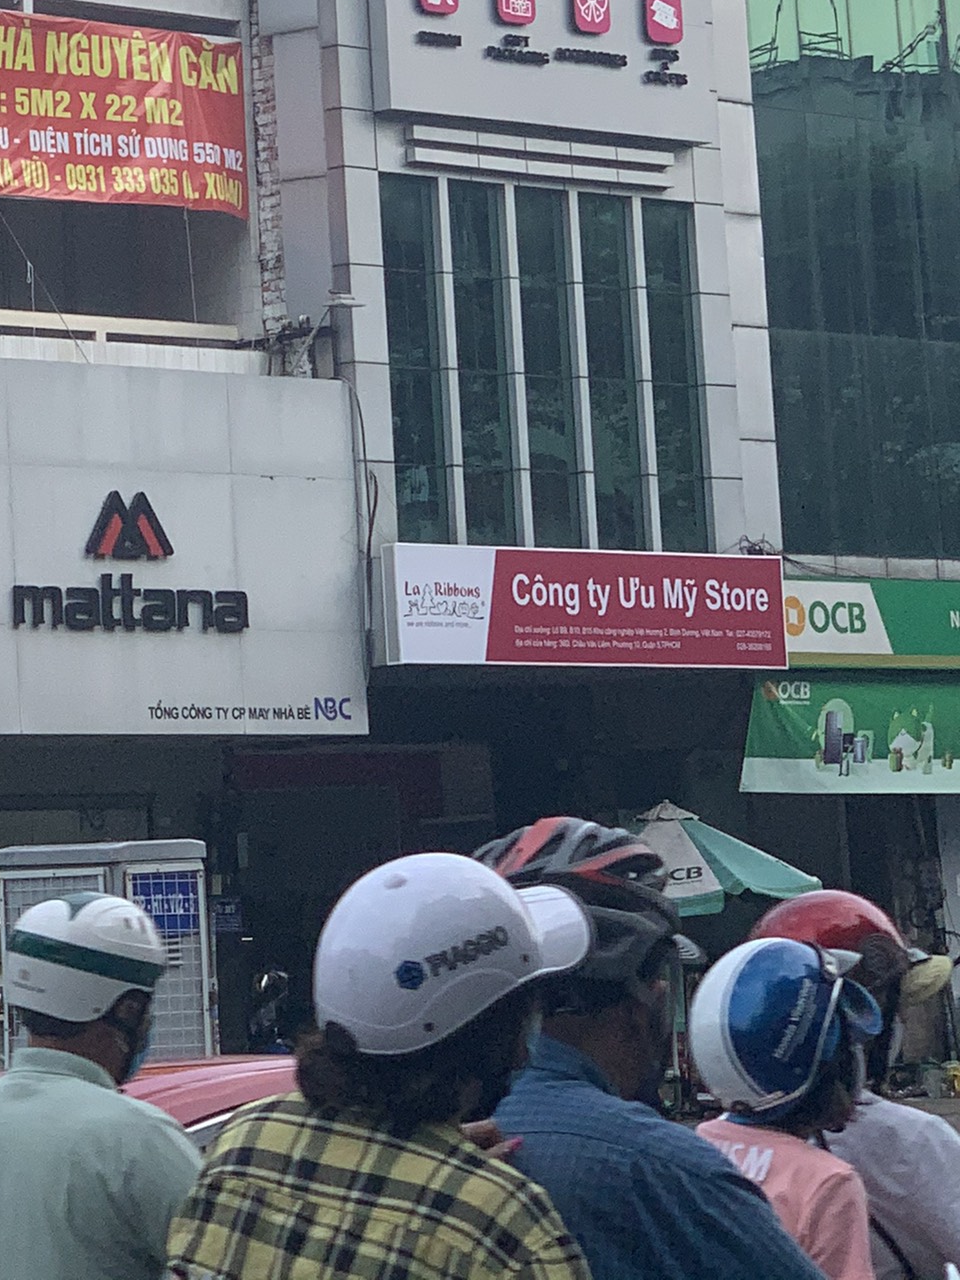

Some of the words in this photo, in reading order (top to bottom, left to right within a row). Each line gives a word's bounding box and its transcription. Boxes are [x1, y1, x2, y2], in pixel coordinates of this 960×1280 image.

[45, 30, 172, 83] NGUYÊN
[179, 40, 239, 95] CĂN
[15, 87, 71, 119] 5M2
[79, 91, 97, 120] X
[105, 93, 138, 123] 22
[144, 96, 184, 126] M2
[29, 126, 69, 158] DIỆN
[73, 128, 113, 157] TÍCH
[117, 128, 140, 158] SỬ
[144, 136, 188, 163] DỤNG
[223, 147, 243, 172] M2
[65, 163, 106, 193] 0931
[112, 166, 146, 194] 333
[149, 167, 179, 196] 035
[13, 573, 249, 632] mattana
[405, 581, 420, 596] La
[434, 582, 481, 599] Ribbons
[512, 573, 579, 615] Công
[587, 577, 610, 616] ty
[618, 577, 655, 608] Ưu
[663, 578, 698, 618] Mỹ
[705, 579, 769, 612] Store
[808, 601, 867, 634] OCB
[778, 681, 811, 699] OCB
[148, 700, 179, 720] TỔNG
[181, 704, 212, 720] CÔNG
[215, 707, 230, 720] TY
[232, 707, 246, 720] CP
[248, 707, 270, 720] MAY
[272, 704, 294, 720] NHÀ
[297, 704, 311, 720] BÈ
[668, 866, 703, 882] CB
